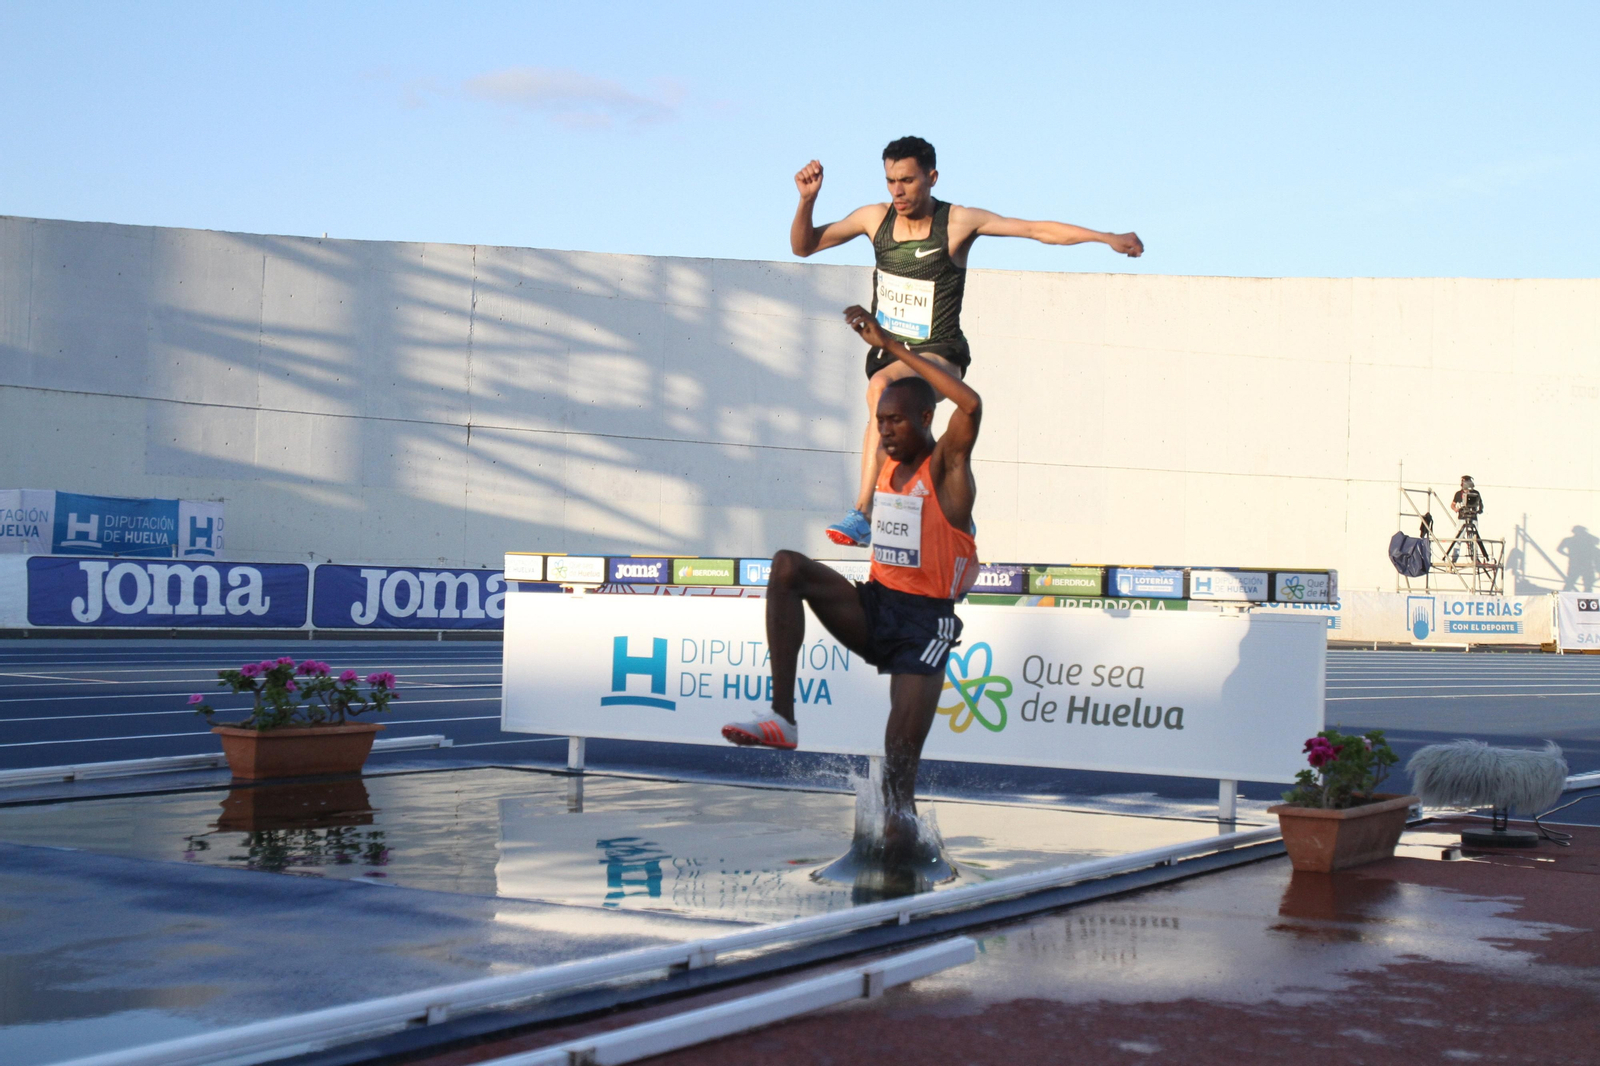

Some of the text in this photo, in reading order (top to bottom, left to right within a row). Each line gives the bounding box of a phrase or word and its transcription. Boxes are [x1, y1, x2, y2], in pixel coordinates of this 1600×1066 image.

[880, 285, 928, 308] SIGUENI
[893, 306, 905, 318] 11
[104, 515, 174, 531] DIPUTACIÓN
[877, 520, 909, 537] PACER
[103, 530, 169, 546] DE HUELVA
[692, 568, 730, 577] IBERDROLA
[1052, 578, 1096, 587] IBERDROLA
[1135, 576, 1174, 585] LOTERÍAS
[1215, 576, 1264, 586] DIPUTACIÓN
[1307, 578, 1325, 589] Que
[1227, 585, 1259, 594] HUELVA
[1307, 588, 1318, 598] de
[1443, 599, 1523, 617] LOTERÍAS
[1452, 623, 1515, 632] CON EL DEPORTE
[1022, 654, 1145, 690] Que sea
[680, 671, 713, 699] DE
[1020, 691, 1185, 731] de Huelva
